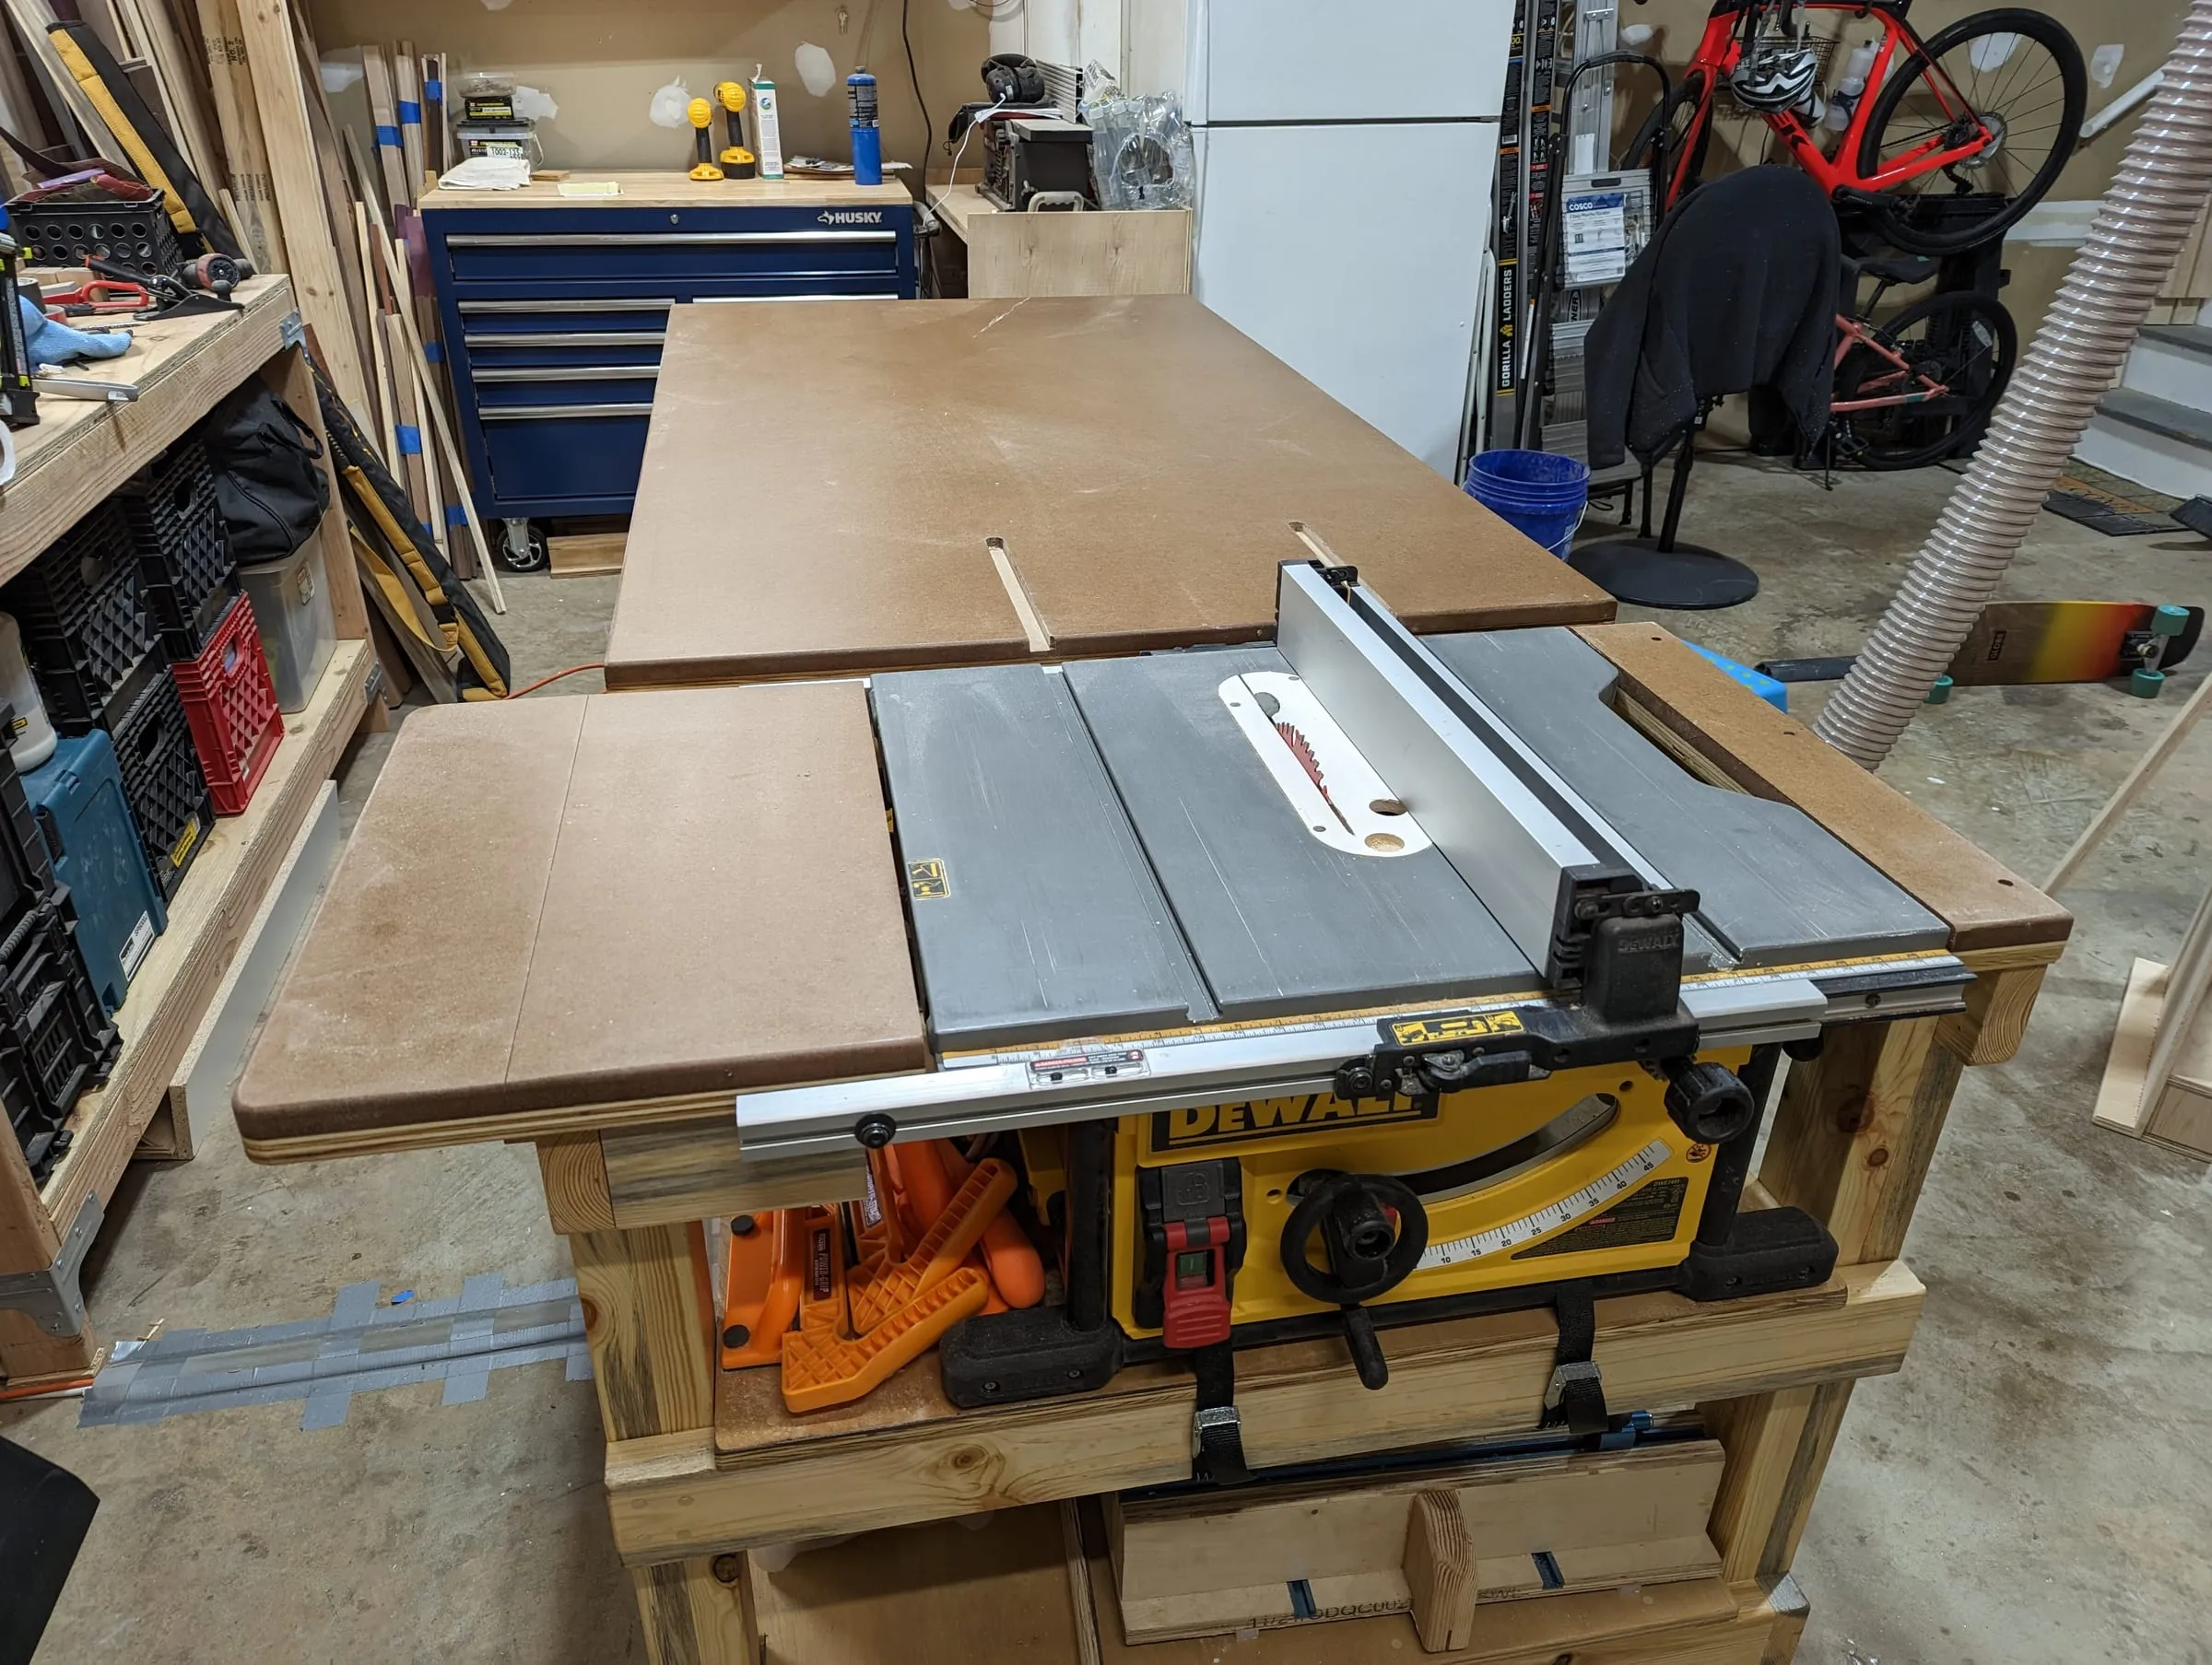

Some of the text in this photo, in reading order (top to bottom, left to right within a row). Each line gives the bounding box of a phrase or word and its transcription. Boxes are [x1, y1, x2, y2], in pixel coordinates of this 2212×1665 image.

[834, 211, 882, 224] HUSKY
[1569, 202, 1594, 211] COSCO
[1501, 269, 1512, 388] GORILLA LADDERS
[1441, 1162, 1655, 1264] 10 15 20 25 30 35 40 45
